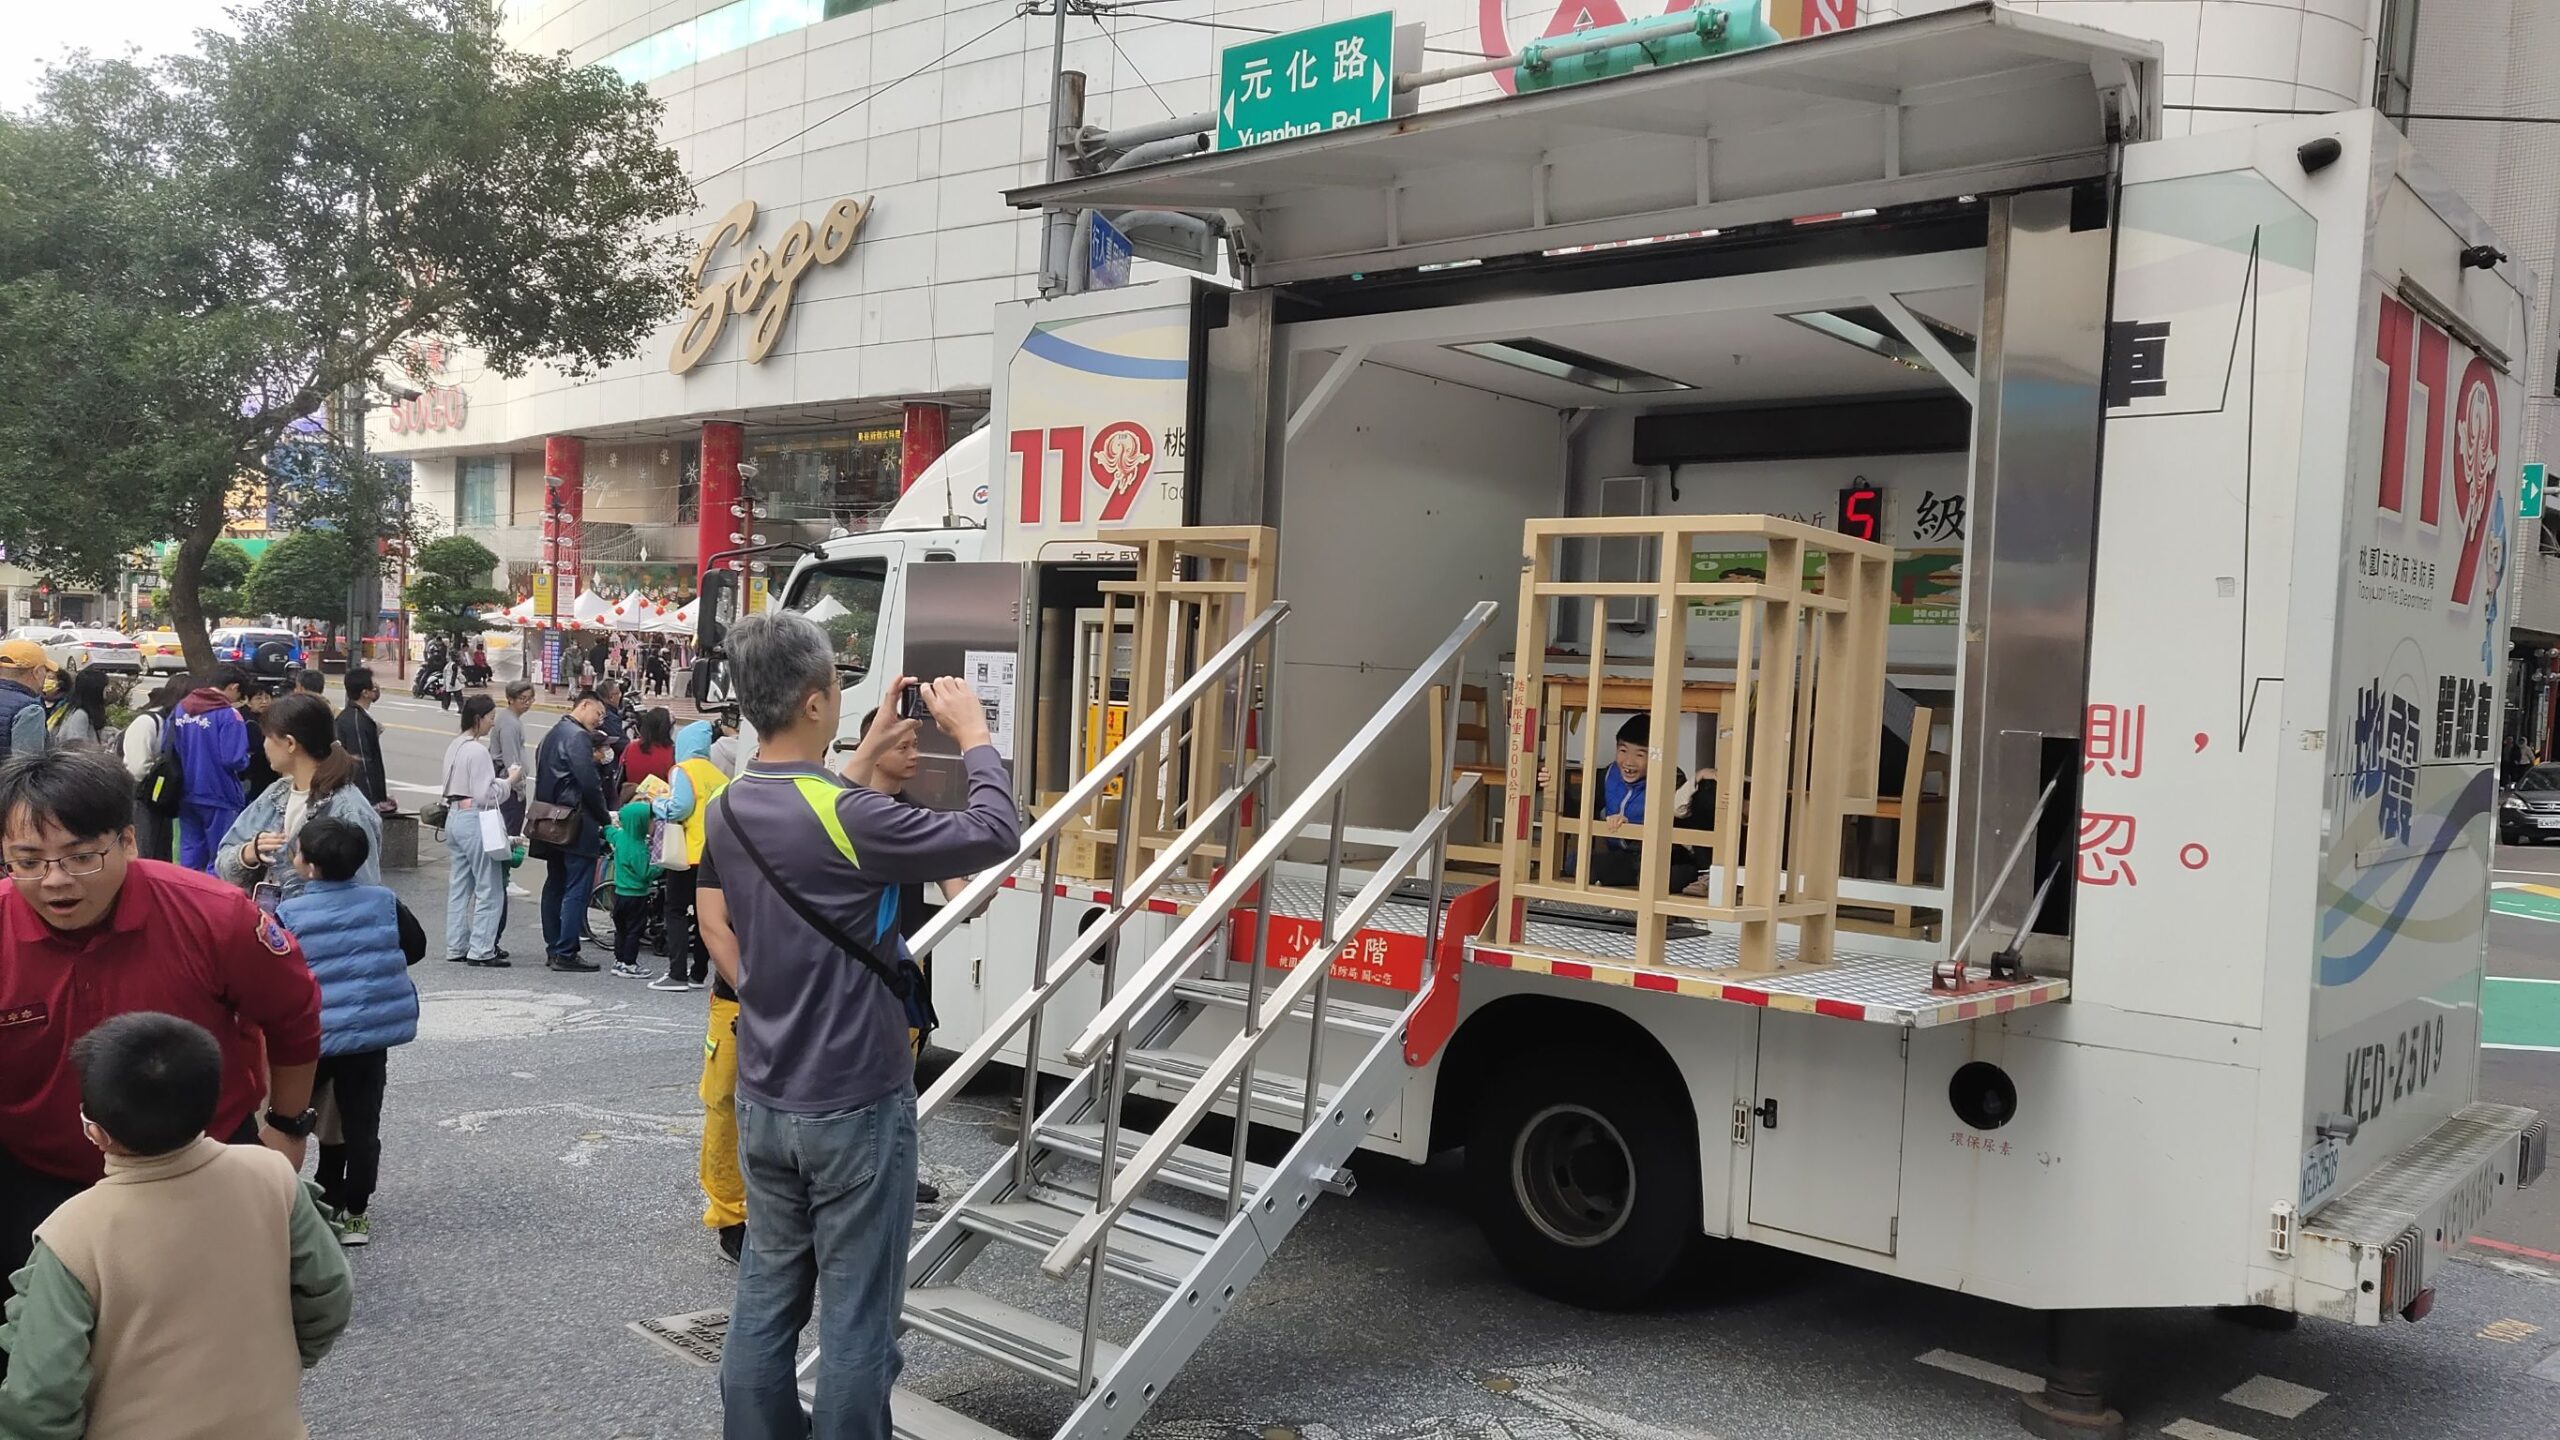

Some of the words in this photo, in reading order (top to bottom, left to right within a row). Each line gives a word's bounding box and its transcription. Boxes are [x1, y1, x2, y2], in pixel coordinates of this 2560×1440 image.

[1240, 35, 1368, 102] 元化路
[1237, 120, 1321, 147] Yuanhua
[669, 195, 874, 375] Sogo
[389, 385, 464, 432] SOGO
[1164, 426, 1186, 457] 桃
[2376, 291, 2500, 606] 119
[1010, 421, 1154, 523] 119
[1847, 491, 1876, 541] 5
[1913, 491, 1965, 542] 級
[1288, 924, 1388, 967] 小台階
[2344, 1014, 2443, 1126] KED-2509
[2301, 1148, 2339, 1206] KED-2509
